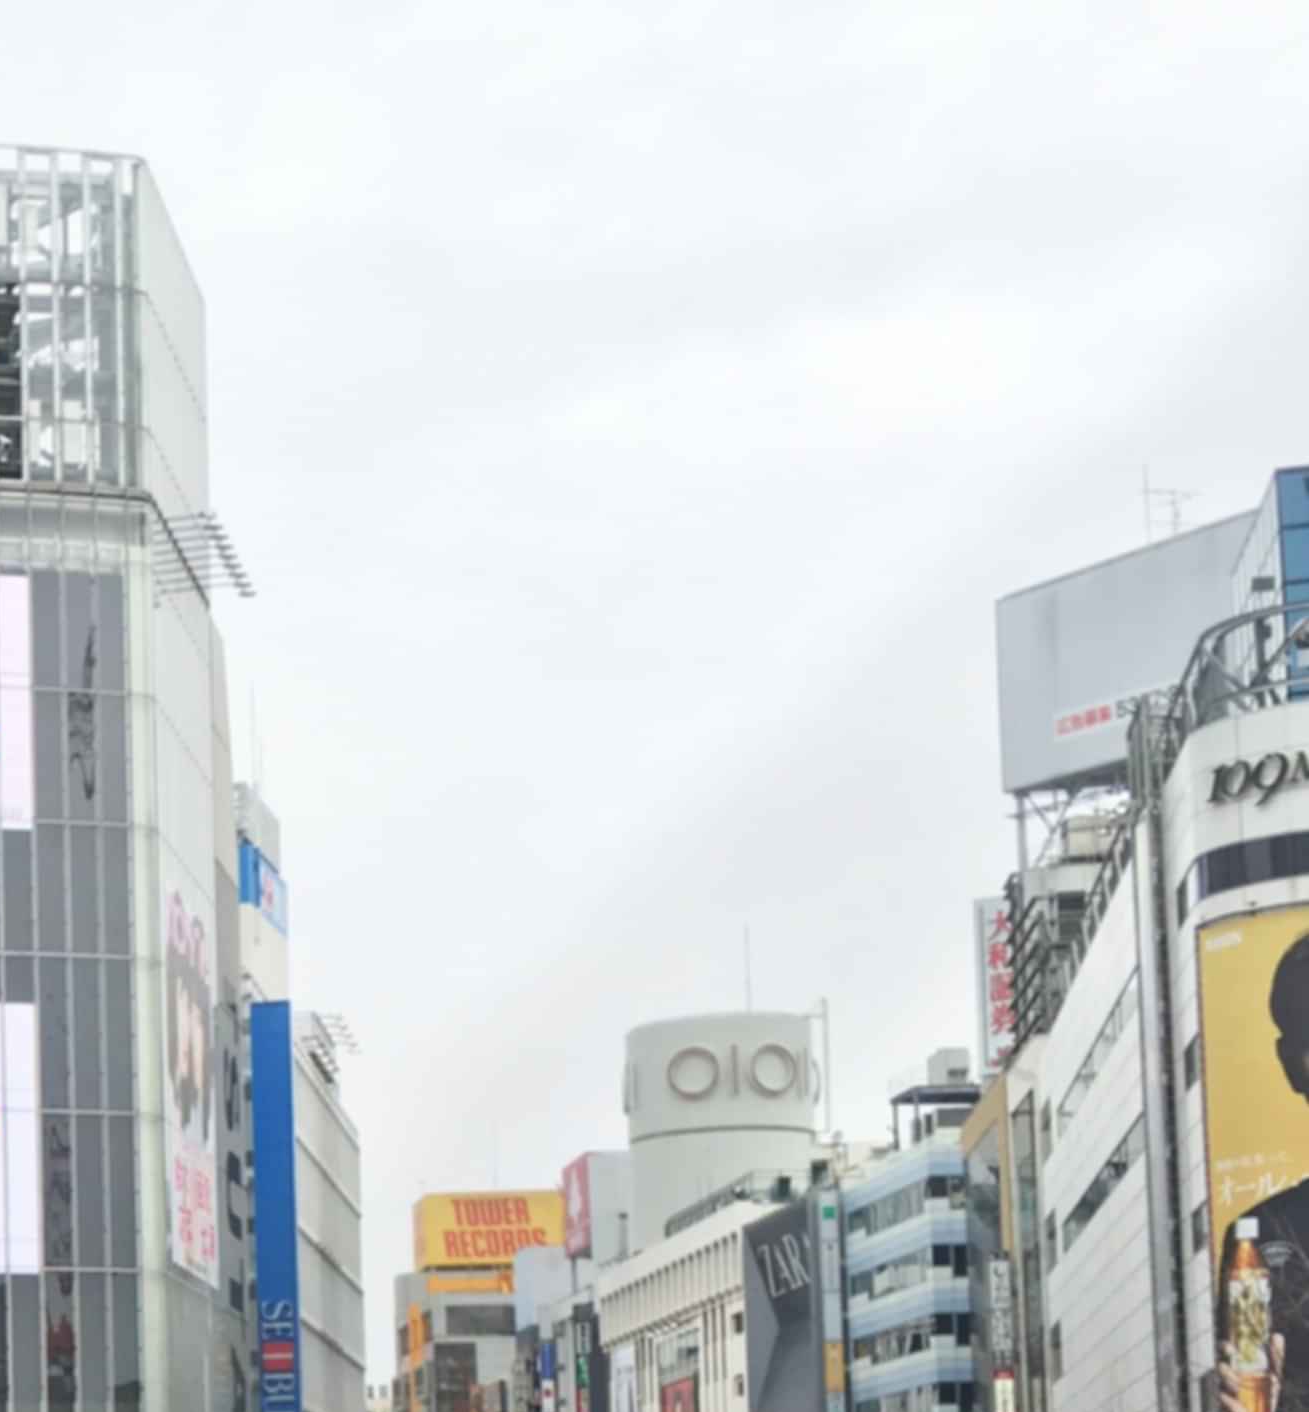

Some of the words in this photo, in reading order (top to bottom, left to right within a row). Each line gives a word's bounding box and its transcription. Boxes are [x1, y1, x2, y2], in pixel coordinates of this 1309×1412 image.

[452, 1197, 531, 1227] TOWER
[444, 1229, 546, 1261] RECORDS
[758, 1232, 811, 1298] ZAR
